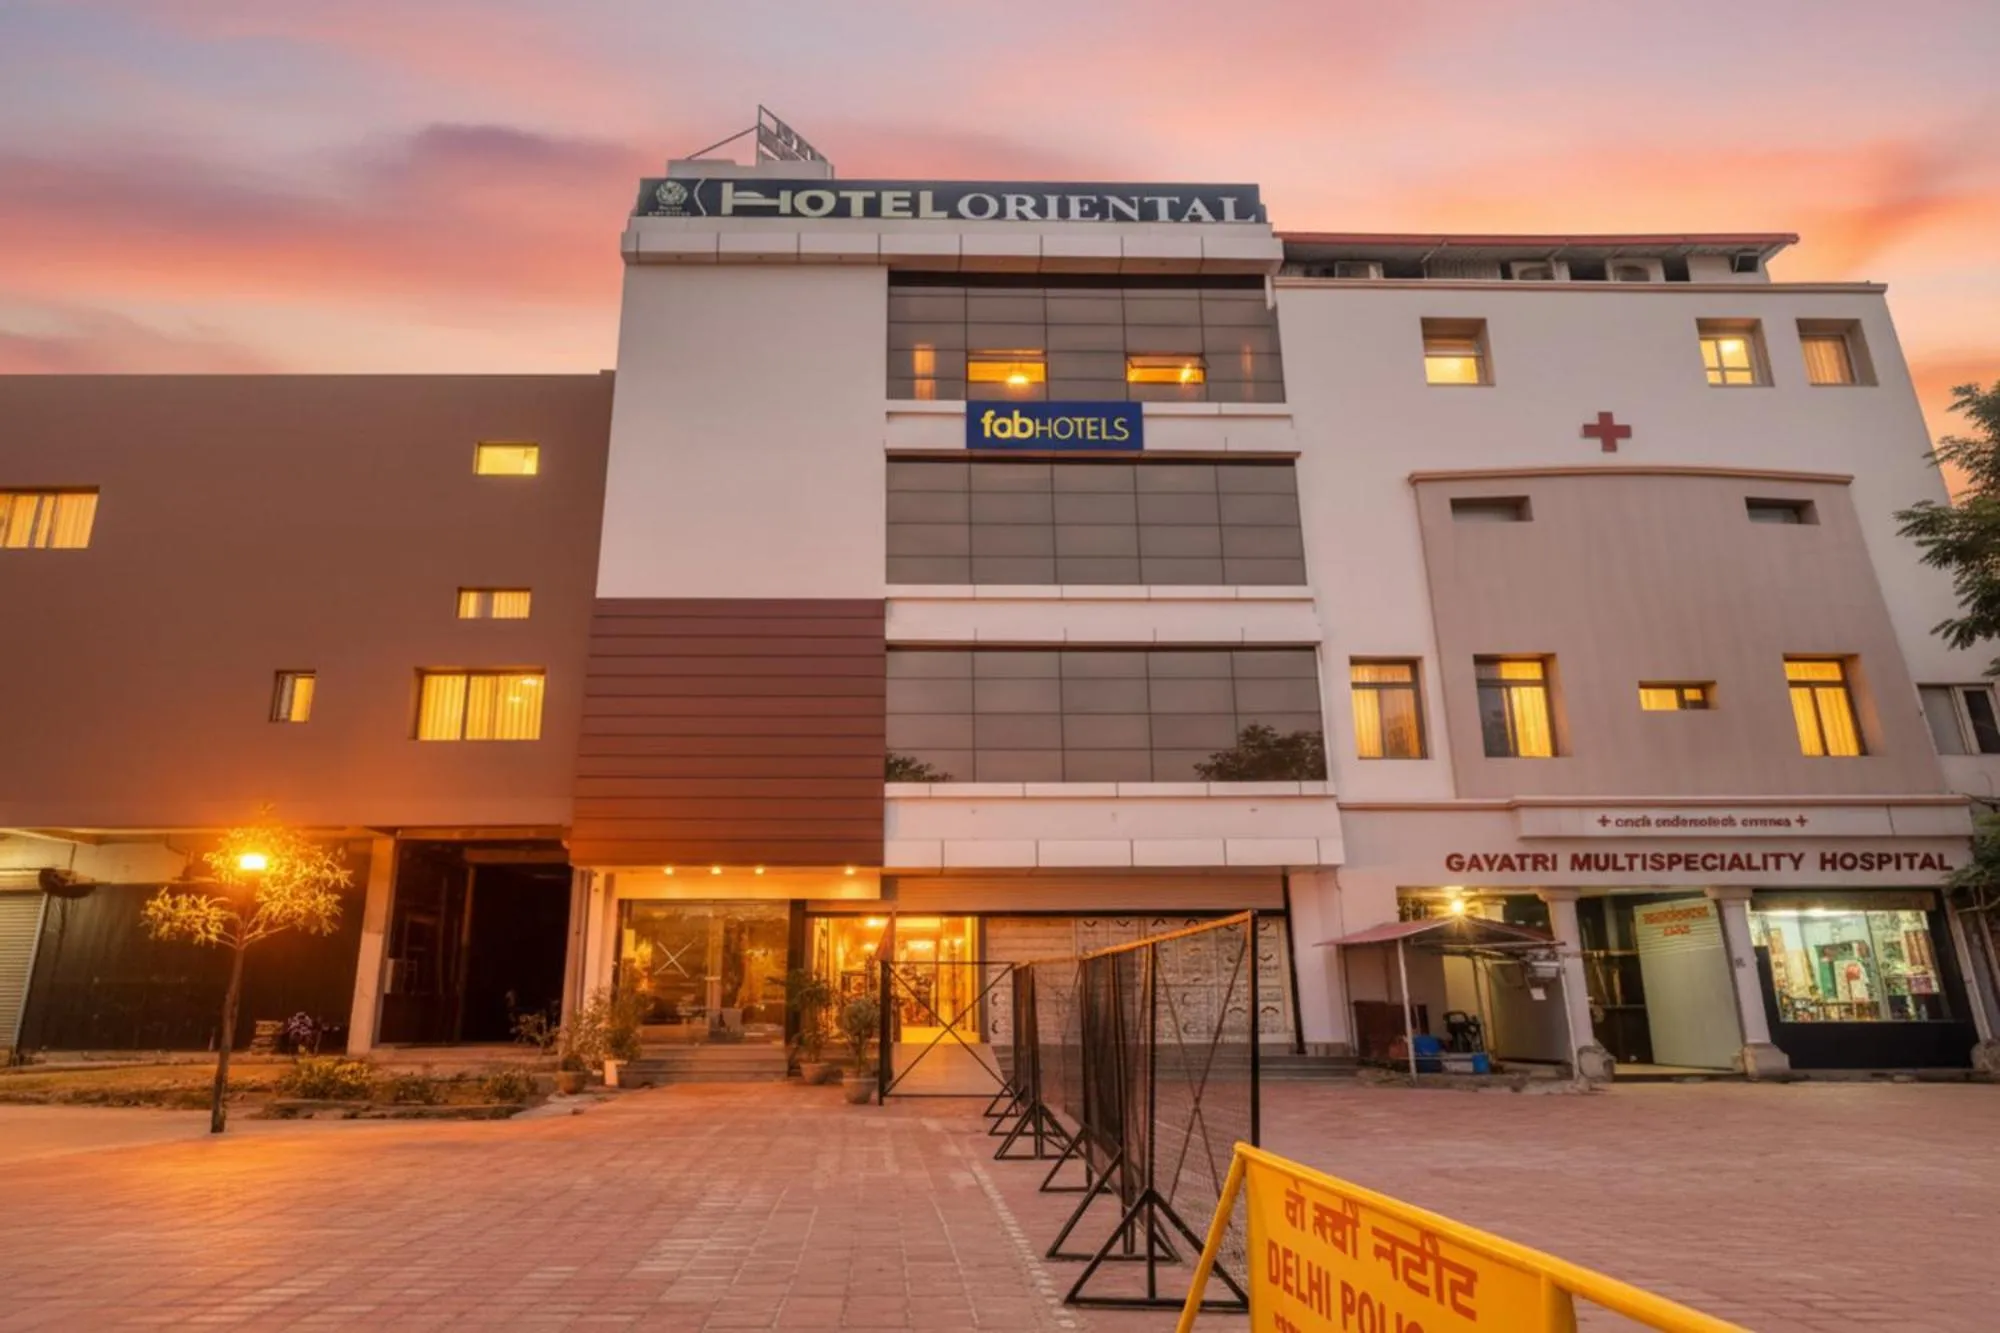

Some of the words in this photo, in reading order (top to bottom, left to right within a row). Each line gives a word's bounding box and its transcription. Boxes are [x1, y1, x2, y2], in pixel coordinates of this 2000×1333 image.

[721, 182, 948, 218] HOTEL
[957, 192, 1257, 223] ORIENTAL
[981, 410, 1130, 441] fabHOTELS
[1445, 851, 1557, 873] GAYATRI
[1569, 852, 1805, 873] MULTISPECIALITY
[1819, 851, 1953, 872] HOSPITAL
[1267, 1239, 1333, 1322] DELHI
